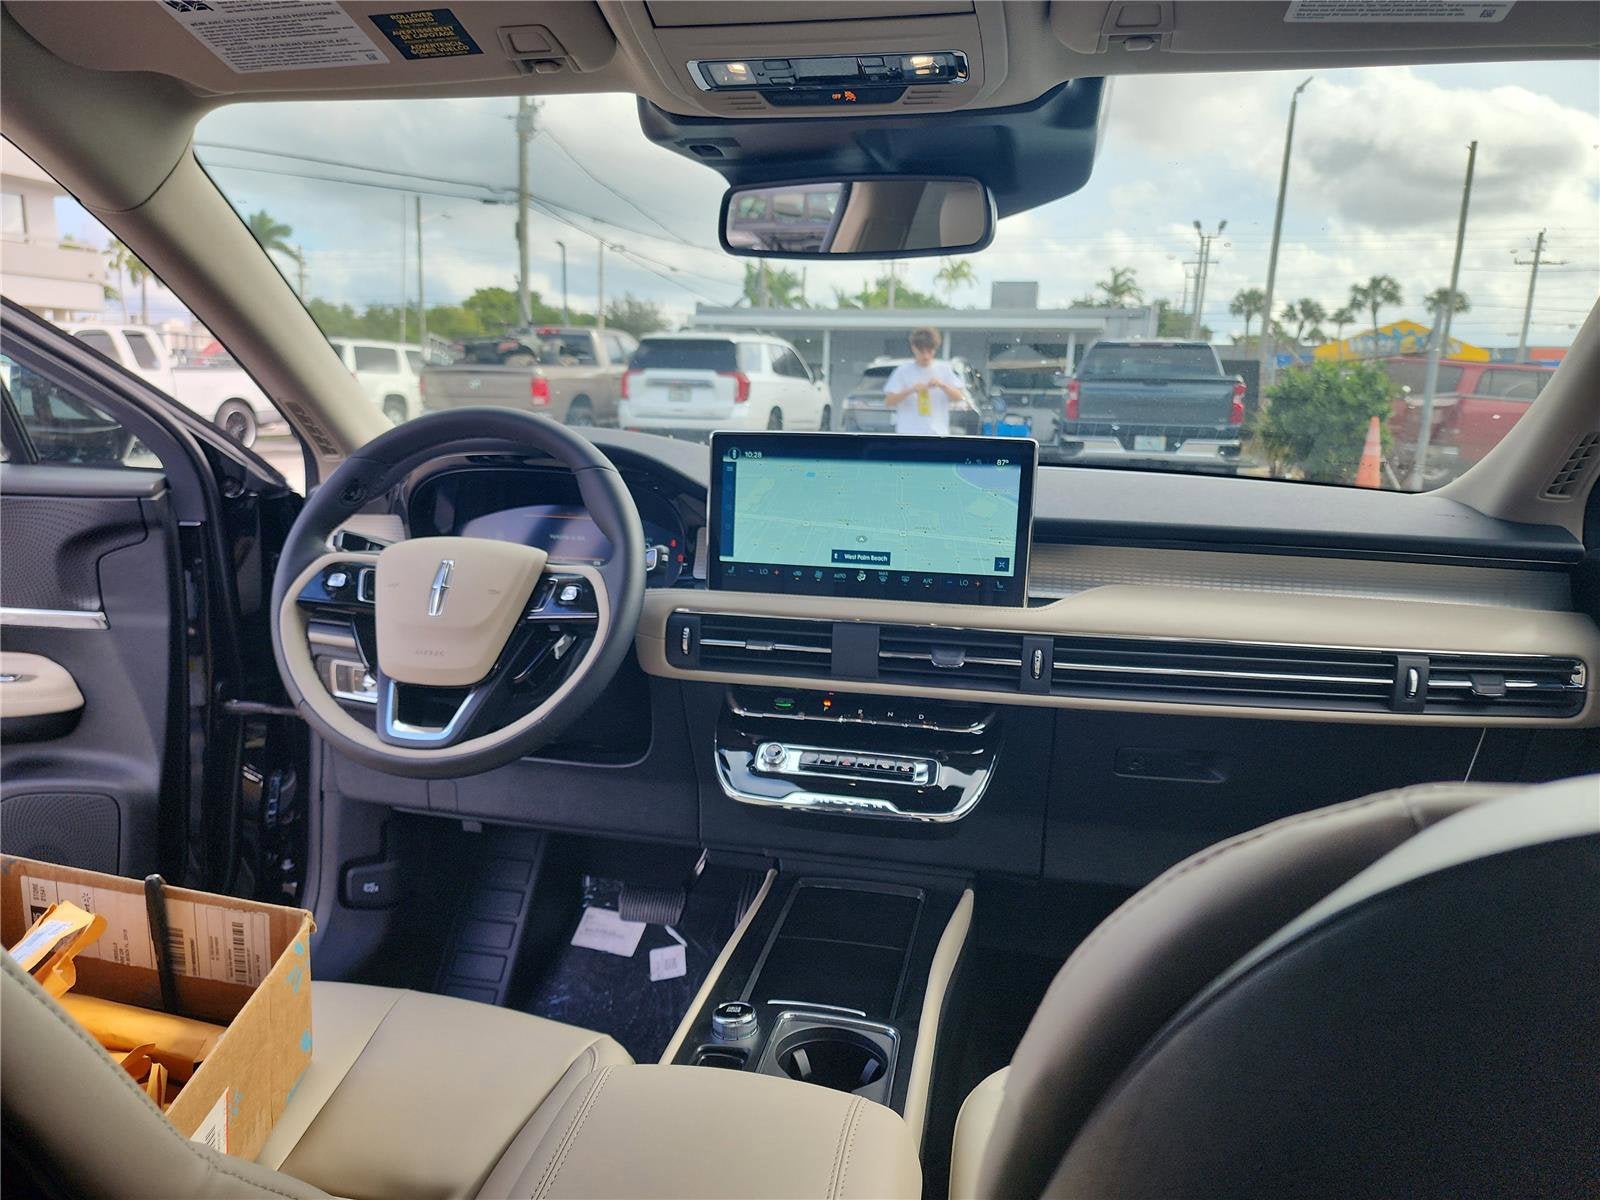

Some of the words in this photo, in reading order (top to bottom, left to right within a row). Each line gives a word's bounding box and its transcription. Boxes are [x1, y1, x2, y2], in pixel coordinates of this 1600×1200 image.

[390, 12, 433, 20] ROLLOVER
[397, 17, 435, 25] WARNING
[871, 554, 888, 562] Beach
